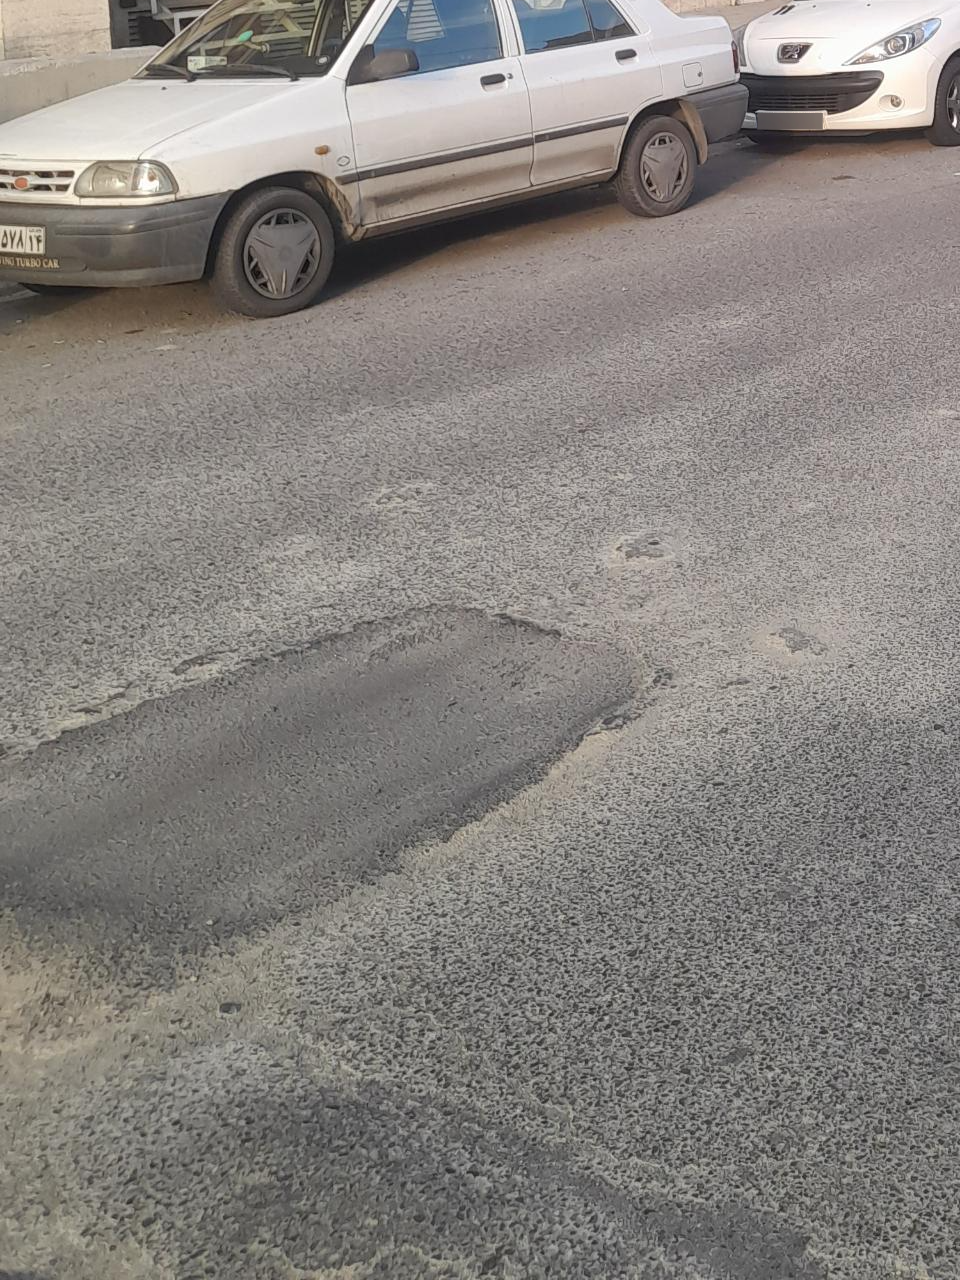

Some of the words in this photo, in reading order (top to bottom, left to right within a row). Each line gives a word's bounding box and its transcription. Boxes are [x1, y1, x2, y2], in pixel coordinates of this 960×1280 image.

[28, 234, 43, 252] ۱۴
[15, 257, 41, 269] TURBO
[42, 258, 60, 269] CAR
